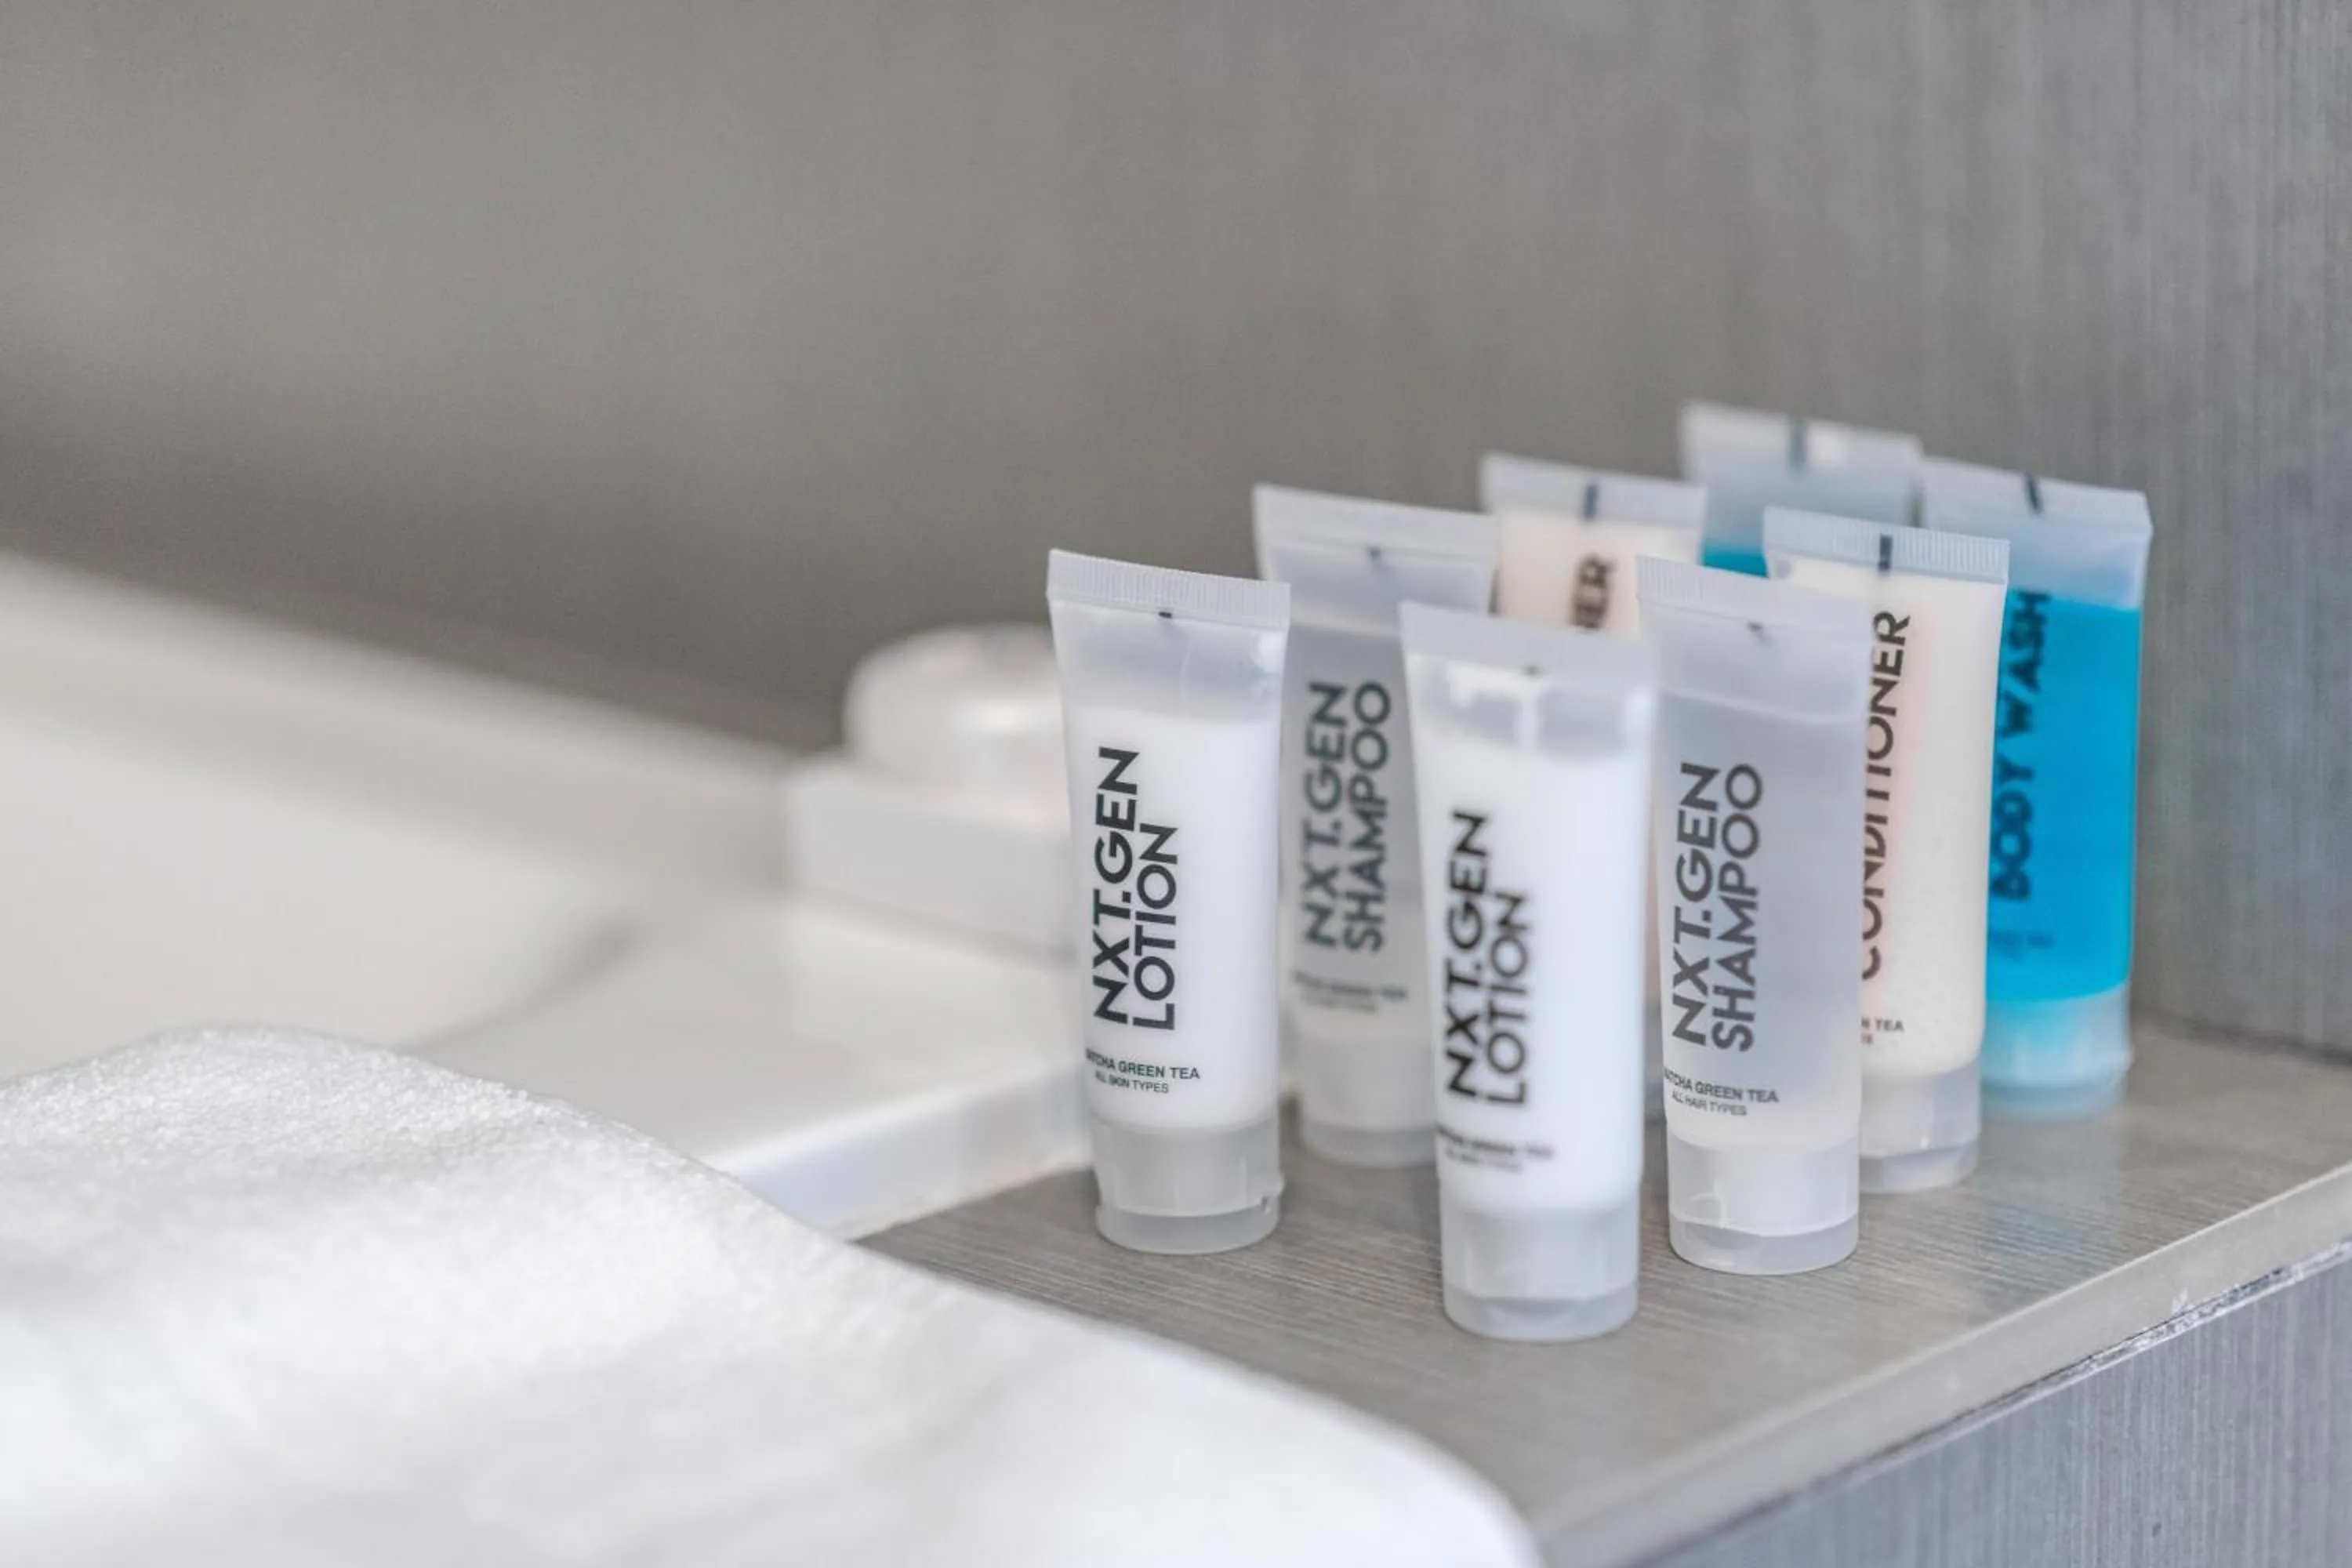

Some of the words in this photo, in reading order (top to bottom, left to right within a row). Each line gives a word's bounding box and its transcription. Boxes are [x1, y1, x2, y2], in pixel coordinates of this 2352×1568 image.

[1092, 746, 1140, 1025] NXT.GEN
[1131, 822, 1179, 1032] LOTION
[1302, 681, 1347, 949] NXT.GEN
[1343, 681, 1391, 953] SHAMPOO
[1671, 762, 1721, 1047] NXT.GEN
[1711, 764, 1764, 1052] SHAMPOO
[1118, 1061, 1166, 1079] GREEN
[1169, 1066, 1201, 1080] TEA
[1443, 809, 1489, 1099] NXT.GEN
[1486, 890, 1530, 1107] LOTION
[1131, 1080, 1170, 1094] TYPES
[1695, 1080, 1744, 1102] GREEN
[1746, 1089, 1780, 1104] TEA
[1709, 1101, 1748, 1116] TYPES
